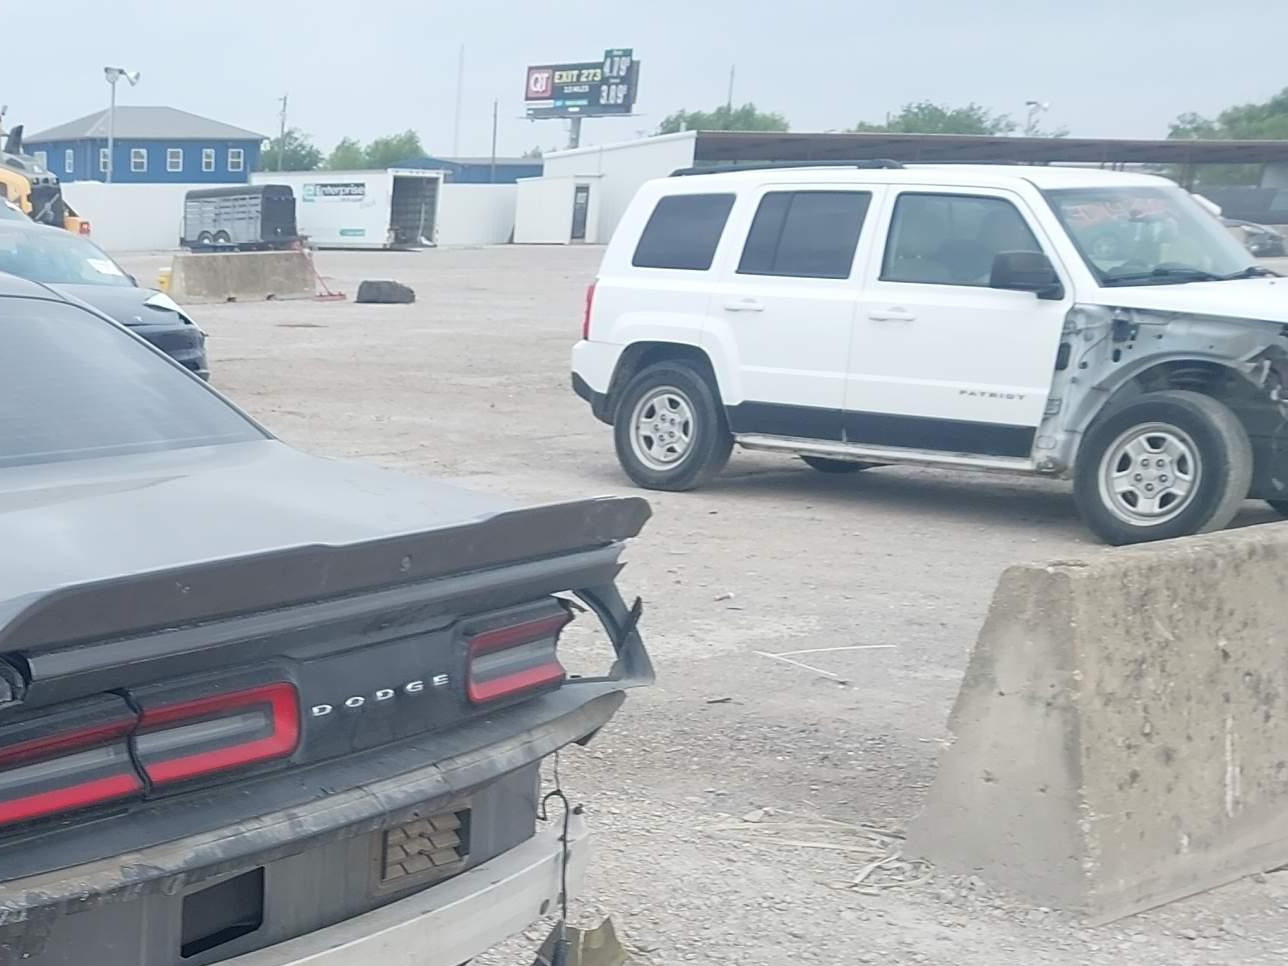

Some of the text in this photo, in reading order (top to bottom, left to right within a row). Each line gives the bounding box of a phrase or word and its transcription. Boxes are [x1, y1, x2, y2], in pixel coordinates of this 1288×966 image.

[530, 73, 549, 92] QT
[554, 69, 601, 83] EXIT 273
[959, 390, 1025, 400] PATRIOT
[311, 674, 449, 716] DODGE
